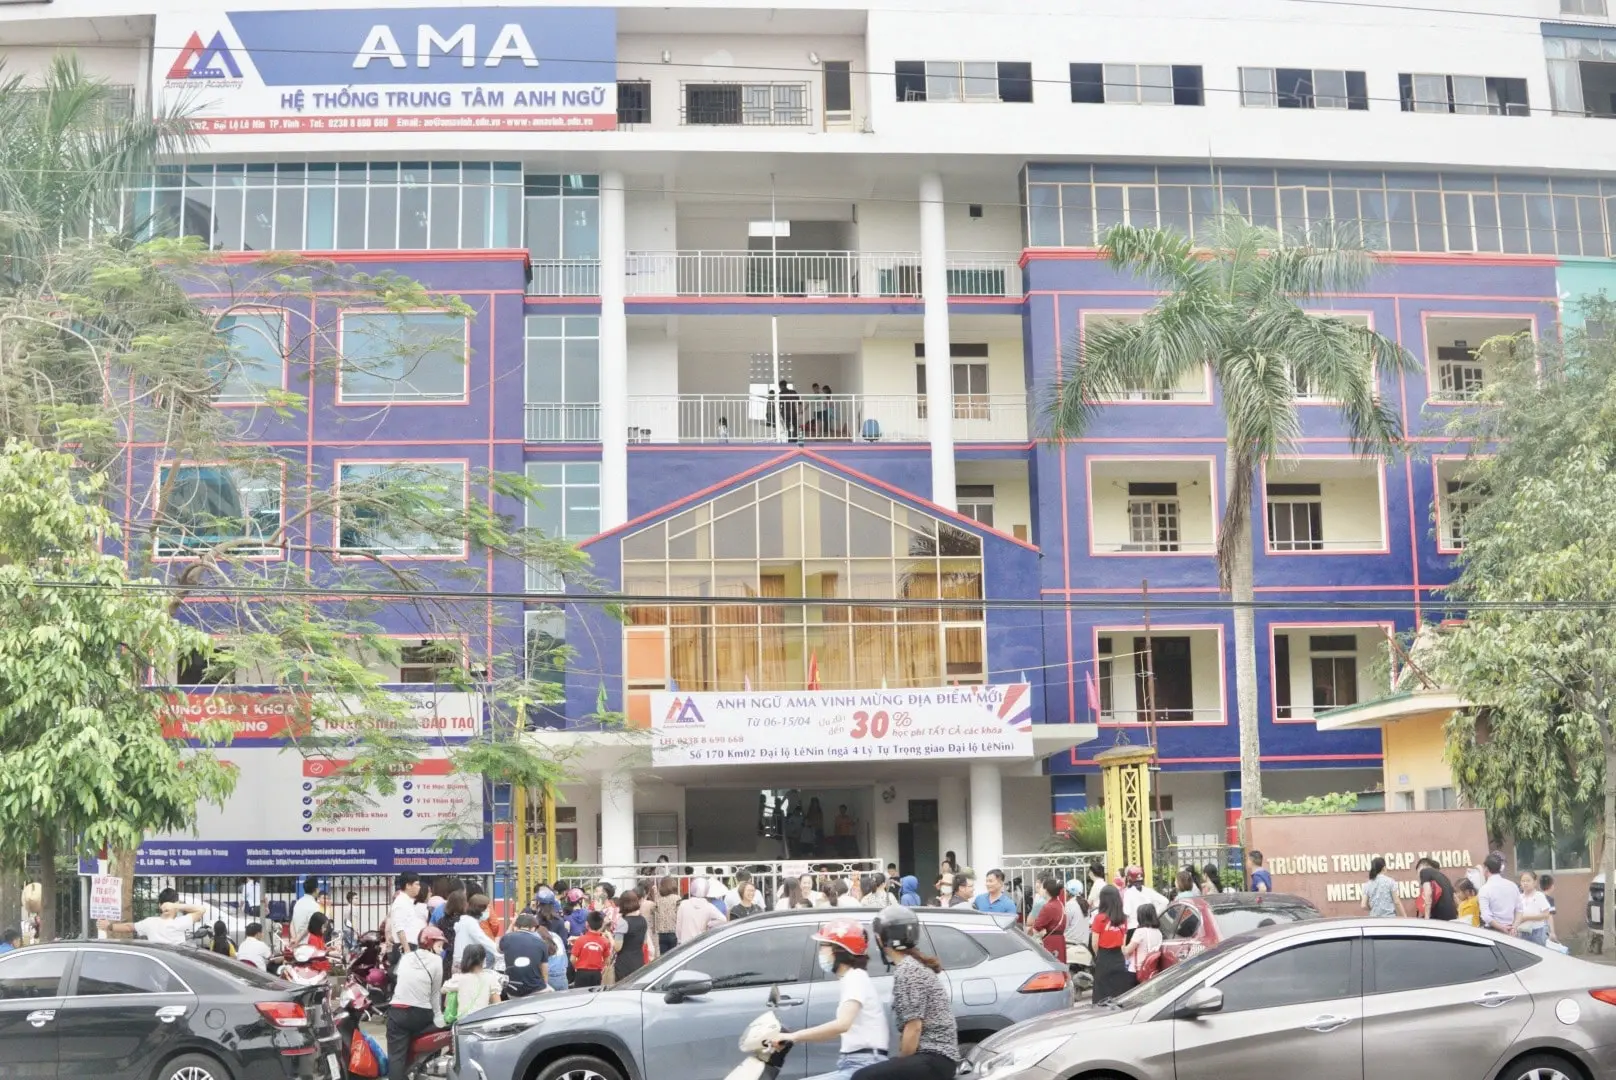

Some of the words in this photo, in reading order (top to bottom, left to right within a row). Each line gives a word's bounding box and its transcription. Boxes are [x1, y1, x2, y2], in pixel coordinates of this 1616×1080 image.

[352, 23, 539, 68] AMA
[281, 89, 305, 112] HỆ
[313, 84, 378, 108] THỐNG
[385, 91, 452, 107] TRUNG
[461, 87, 504, 107] TÂM
[513, 90, 556, 106] ANH
[562, 87, 606, 106] NGỮ
[716, 698, 746, 710] ANH
[751, 695, 782, 709] NGỮ
[786, 697, 817, 708] AMA
[821, 695, 856, 707] VINH
[860, 692, 903, 706] MỪNG
[908, 694, 932, 708] ĐỊA
[936, 689, 972, 705] ĐIỂM
[764, 715, 811, 727] 06-15/04
[706, 749, 724, 759] 170
[727, 749, 756, 758] Km02
[760, 748, 778, 758] Đại
[852, 746, 858, 755] 4
[877, 746, 890, 757] Tự
[892, 744, 922, 757] Trọng
[924, 744, 945, 756] giao
[948, 742, 966, 754] Đại
